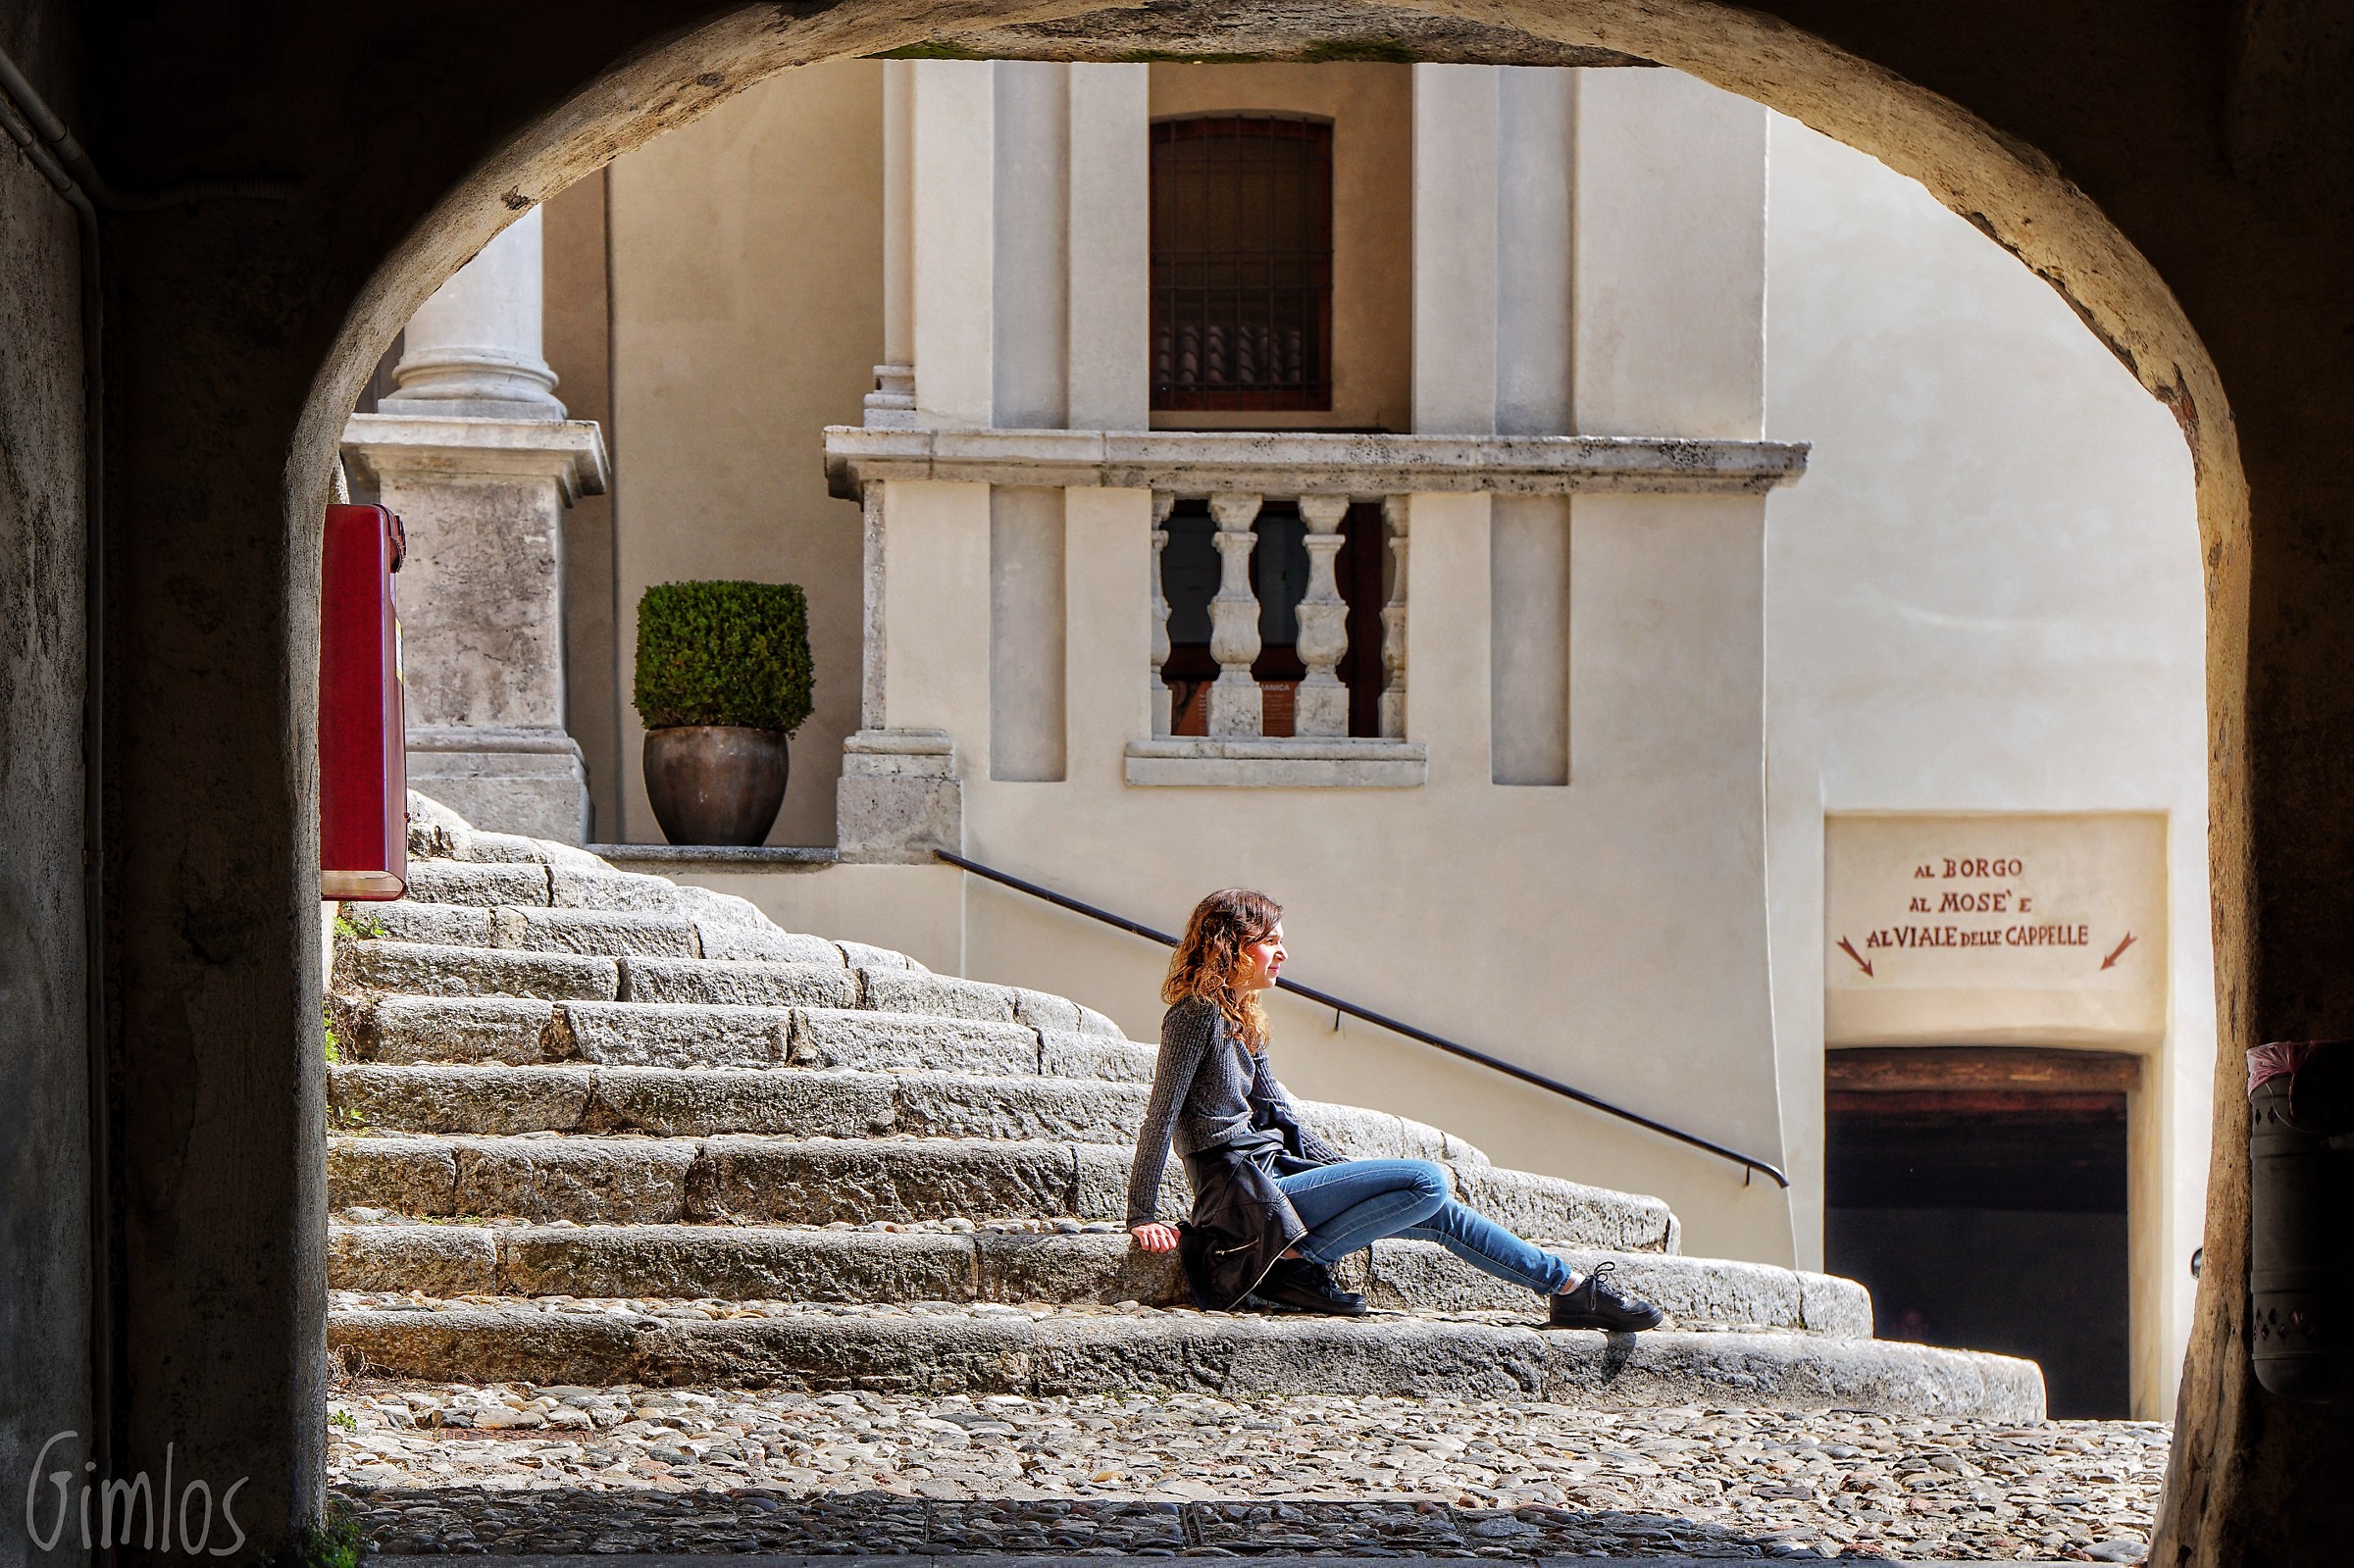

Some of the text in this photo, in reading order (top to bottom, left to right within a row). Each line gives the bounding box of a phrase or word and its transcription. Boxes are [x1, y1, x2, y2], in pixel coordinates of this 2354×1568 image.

[1914, 857, 2022, 879] AL BORGO
[1909, 896, 1931, 913] AL
[2019, 897, 2032, 913] E
[1867, 925, 2089, 948] AL VIALE DELLE CAPPELLE
